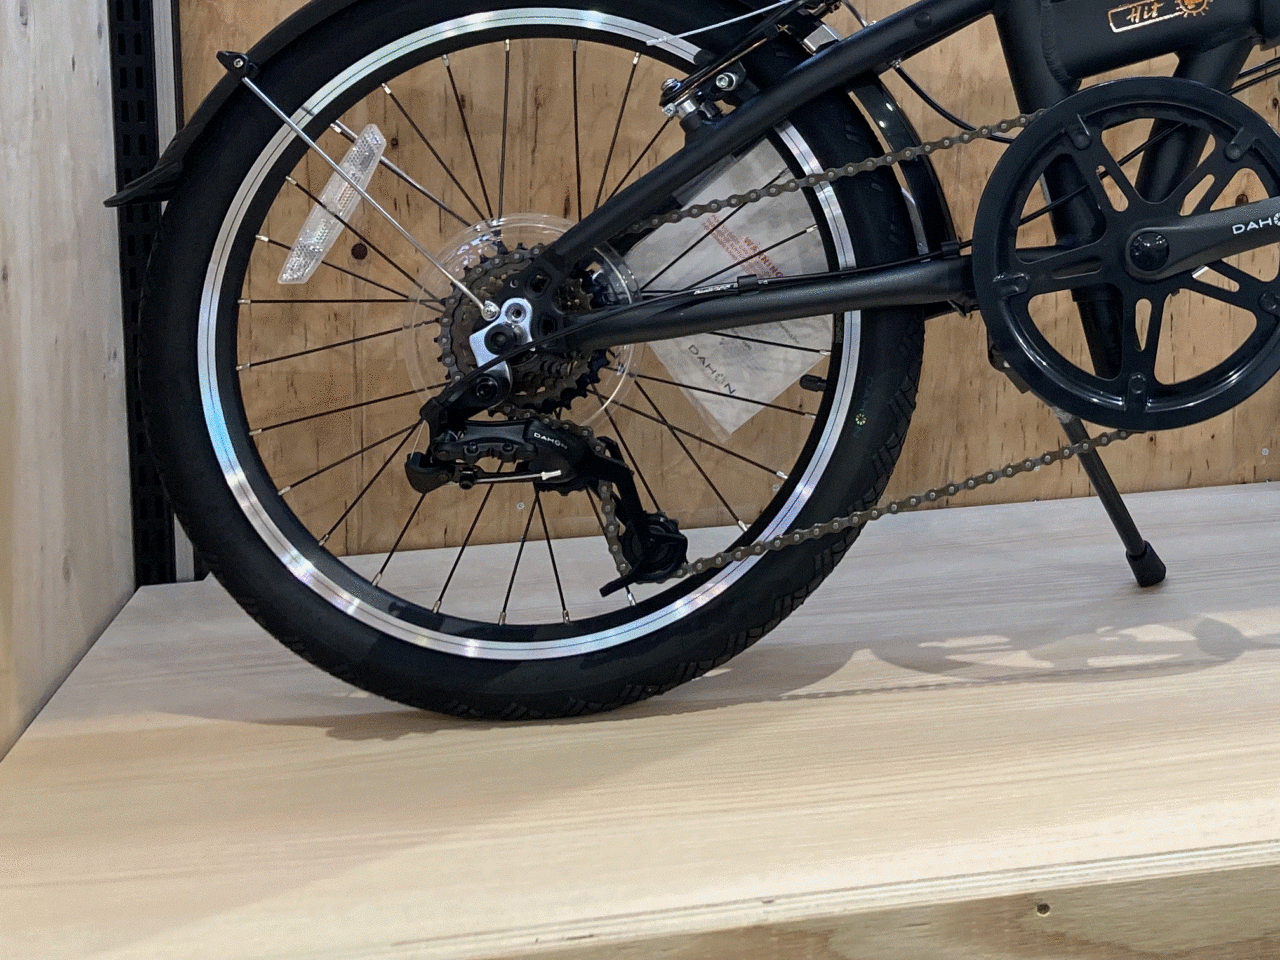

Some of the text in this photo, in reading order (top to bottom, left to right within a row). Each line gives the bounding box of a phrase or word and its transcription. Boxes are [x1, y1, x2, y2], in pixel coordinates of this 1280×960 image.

[1126, 1, 1165, 24] Hit
[688, 344, 736, 395] DAHON
[533, 432, 568, 450] DAHON
